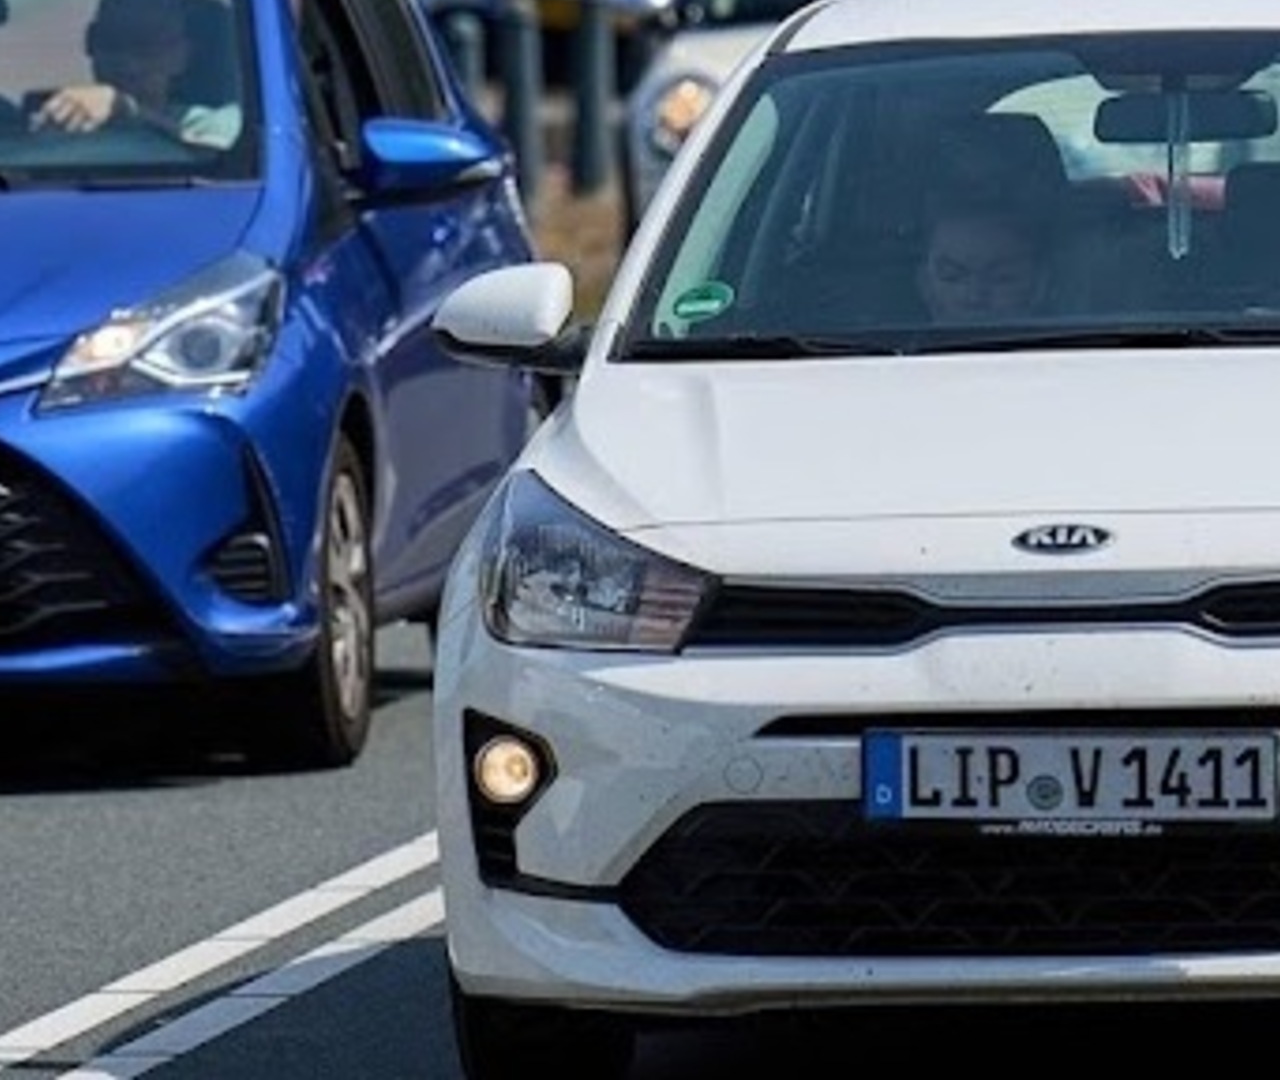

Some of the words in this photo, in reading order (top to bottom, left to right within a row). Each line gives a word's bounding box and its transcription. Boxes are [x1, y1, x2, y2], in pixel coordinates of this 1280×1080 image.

[1024, 526, 1100, 547] KIA
[908, 746, 1019, 809] LIP
[1069, 747, 1103, 809] V
[1122, 745, 1268, 809] 1411
